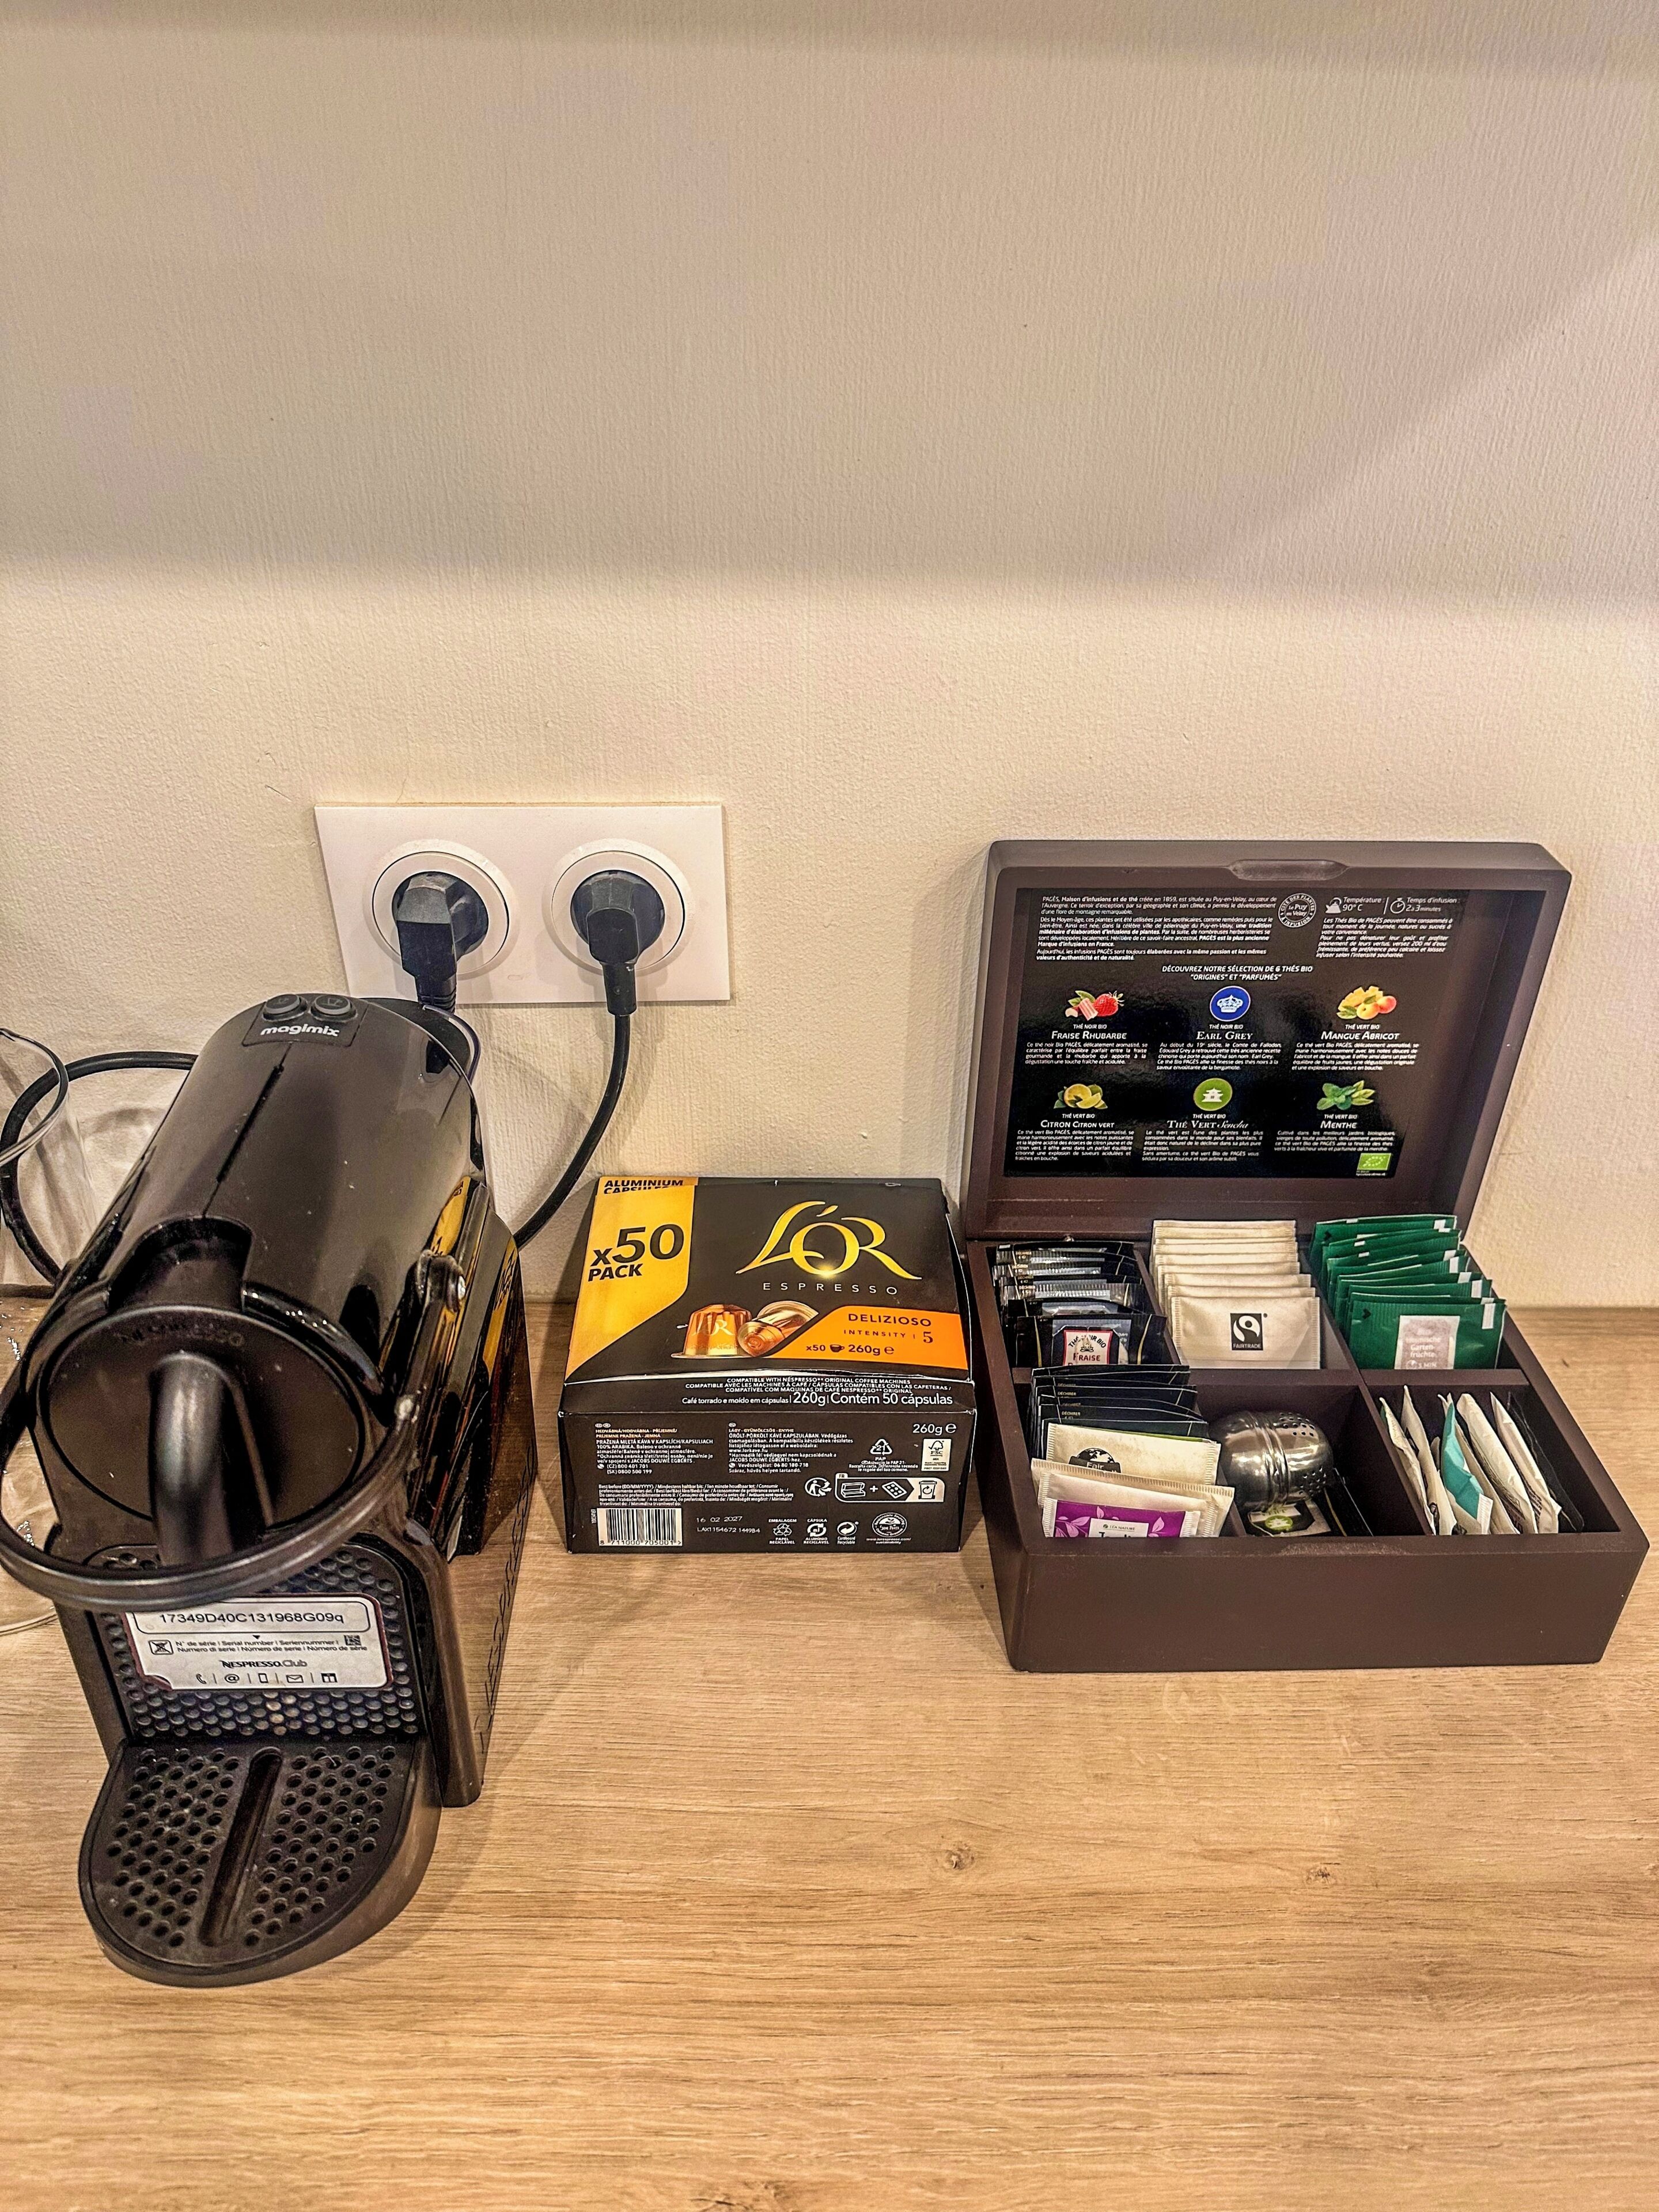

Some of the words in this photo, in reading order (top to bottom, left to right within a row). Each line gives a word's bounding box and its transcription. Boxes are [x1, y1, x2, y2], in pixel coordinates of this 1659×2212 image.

[1282, 964, 1298, 972] THÉS
[260, 1024, 340, 1036] magimix
[1052, 1031, 1080, 1039] FRAISE
[1082, 1031, 1127, 1039] RHUBARBE
[1196, 1031, 1222, 1040] EARL
[1225, 1031, 1253, 1040] GREY
[1321, 1031, 1361, 1040] MANGUE
[1362, 1031, 1400, 1040] ABRICOT
[1040, 1120, 1070, 1128] CITRON
[1167, 1120, 1188, 1128] THÉ
[1191, 1120, 1217, 1128] VERT
[605, 1180, 683, 1188] ALUMINIUM
[590, 1224, 684, 1267] x50
[588, 1264, 643, 1282] PACK
[763, 1282, 897, 1296] ESPRESSO
[849, 1313, 931, 1327] DELIZIOSO
[844, 1330, 906, 1338] INTENSITY
[923, 1331, 933, 1344] 5
[1097, 1338, 1106, 1348] BIO
[849, 1344, 880, 1356] 260g
[762, 1397, 789, 1405] cápsulas
[793, 1392, 825, 1406] 260g
[831, 1392, 880, 1404] Contém
[883, 1393, 898, 1404] 50
[901, 1393, 953, 1407] cápsulas
[912, 1423, 942, 1435] 260g
[160, 1613, 344, 1625] 17349D40C131968G09q
